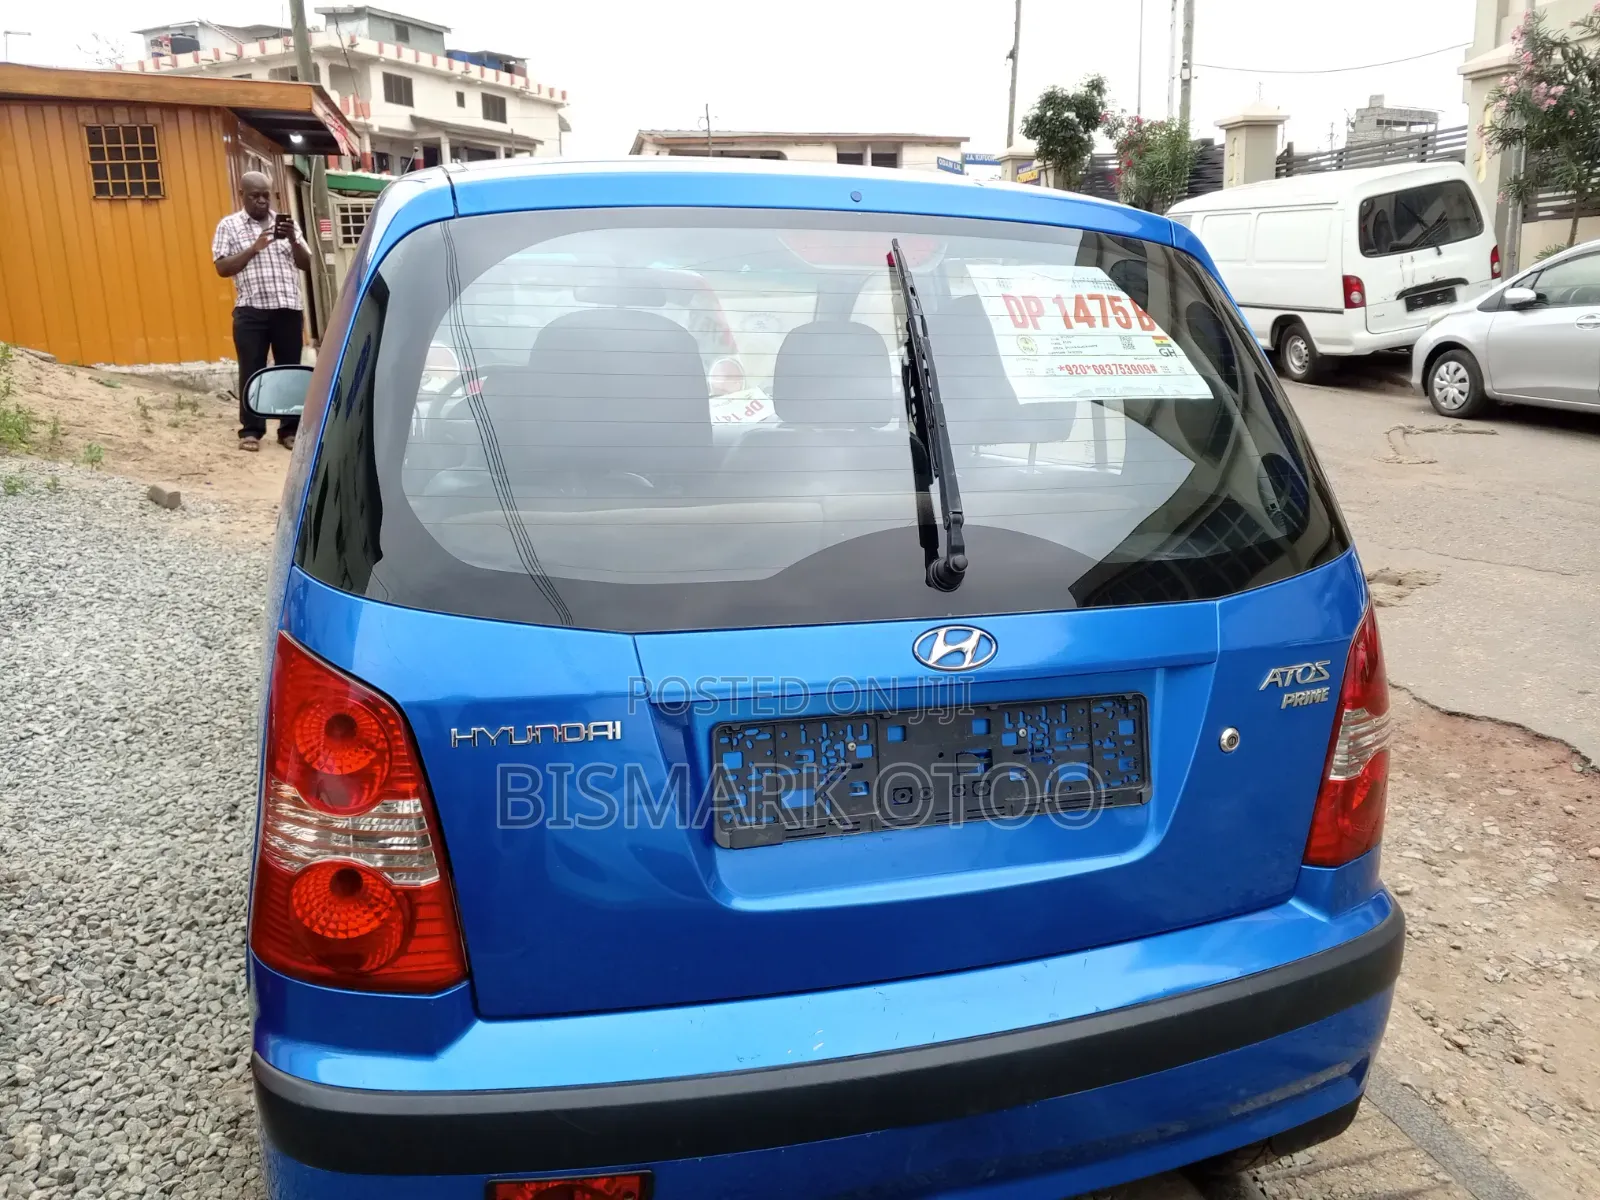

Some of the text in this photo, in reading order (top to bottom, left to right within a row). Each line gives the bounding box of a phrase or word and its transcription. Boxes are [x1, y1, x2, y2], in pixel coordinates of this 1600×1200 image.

[1001, 293, 1045, 330] DP
[1052, 293, 1132, 330] 1475
[1159, 348, 1178, 358] GH
[1259, 660, 1331, 691] ATOS
[1280, 687, 1331, 709] PRIME
[450, 720, 622, 748] HYUNDAI
